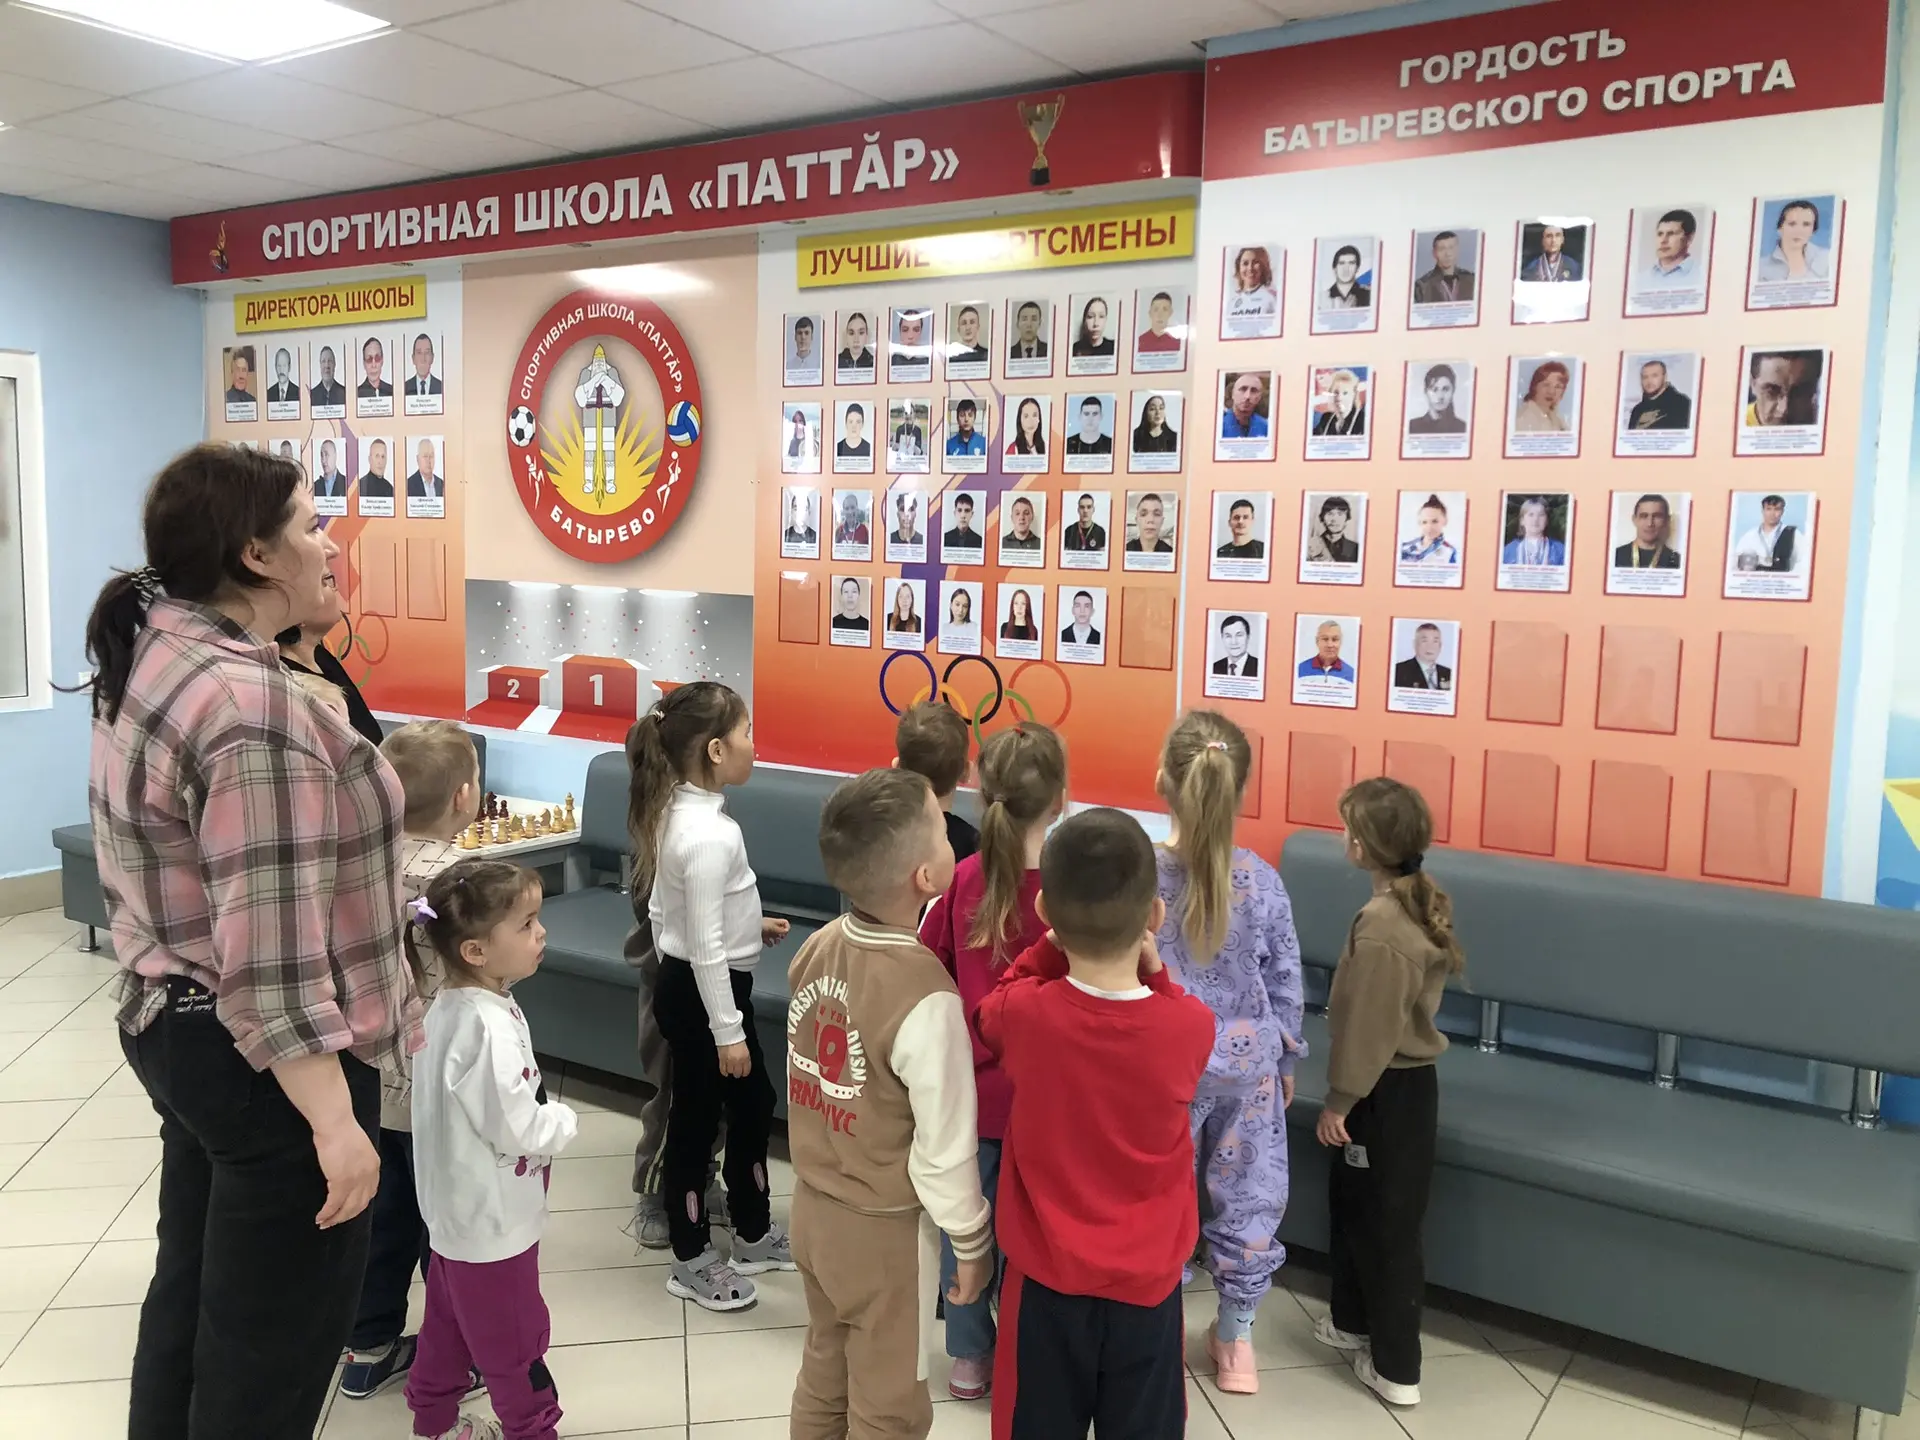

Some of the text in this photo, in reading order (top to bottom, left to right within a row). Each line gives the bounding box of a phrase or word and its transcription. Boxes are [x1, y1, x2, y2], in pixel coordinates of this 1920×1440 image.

[1399, 28, 1627, 88] ГОРДОСТЬ
[1263, 58, 1796, 155] БАТЫРЕВСКОГО СПОРТА
[262, 196, 499, 260] СПОРТИВНАЯ
[514, 174, 673, 233] ШКОЛА
[944, 216, 1177, 268] РТСМЕНЫ
[245, 285, 415, 325] ДИРЕКТОРА ШКОЛЫ
[521, 308, 584, 400] СПОРТИВНАЯ
[587, 303, 635, 325] ШКОЛА
[550, 504, 655, 545] БАТЫРЕВО
[507, 678, 520, 698] 2
[589, 674, 603, 706] 1
